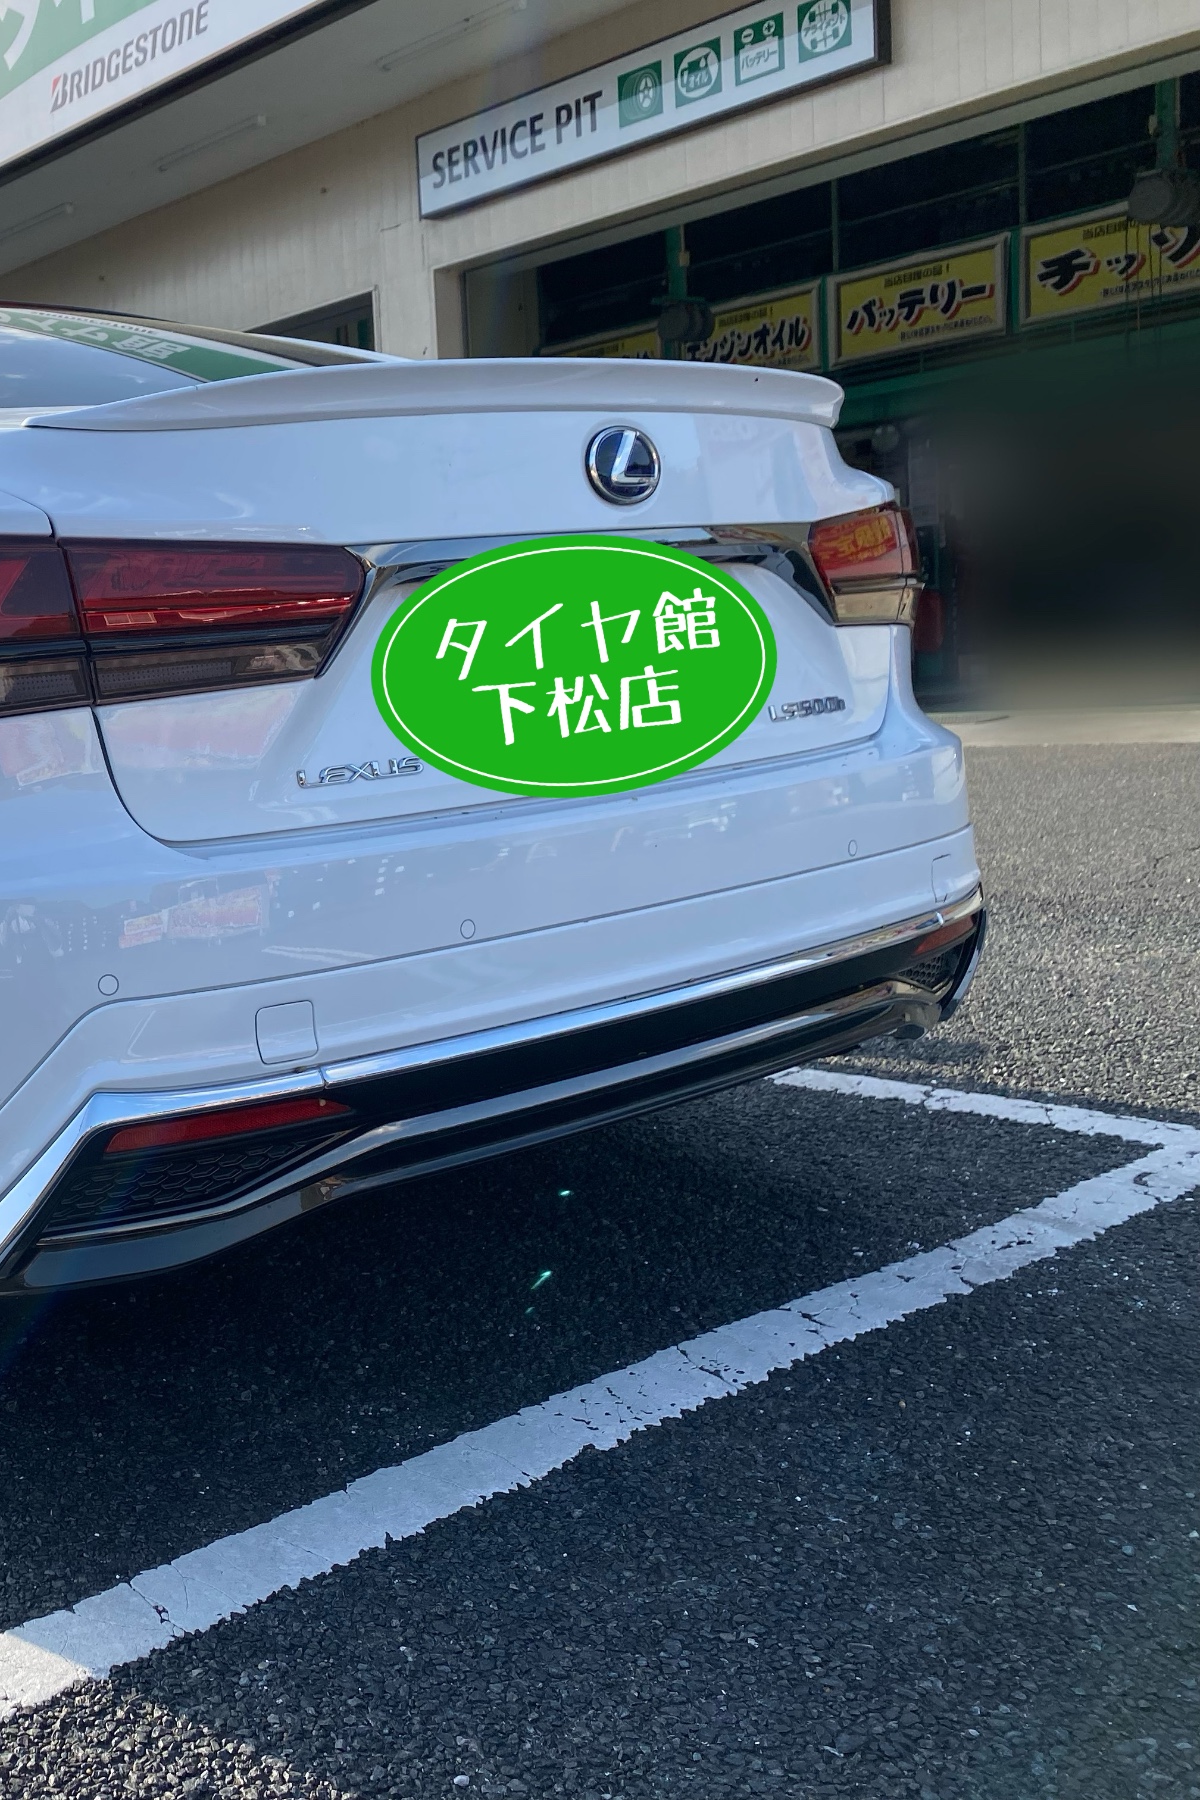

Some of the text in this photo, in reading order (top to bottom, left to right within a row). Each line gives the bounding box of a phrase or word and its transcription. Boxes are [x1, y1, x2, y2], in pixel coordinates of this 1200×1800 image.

[50, 0, 209, 112] BRIDGESTONE
[742, 49, 778, 70] バッテリー
[432, 90, 603, 189] SERVICE PIT
[847, 279, 994, 333] バッテリー
[296, 756, 424, 789] LEXUS
